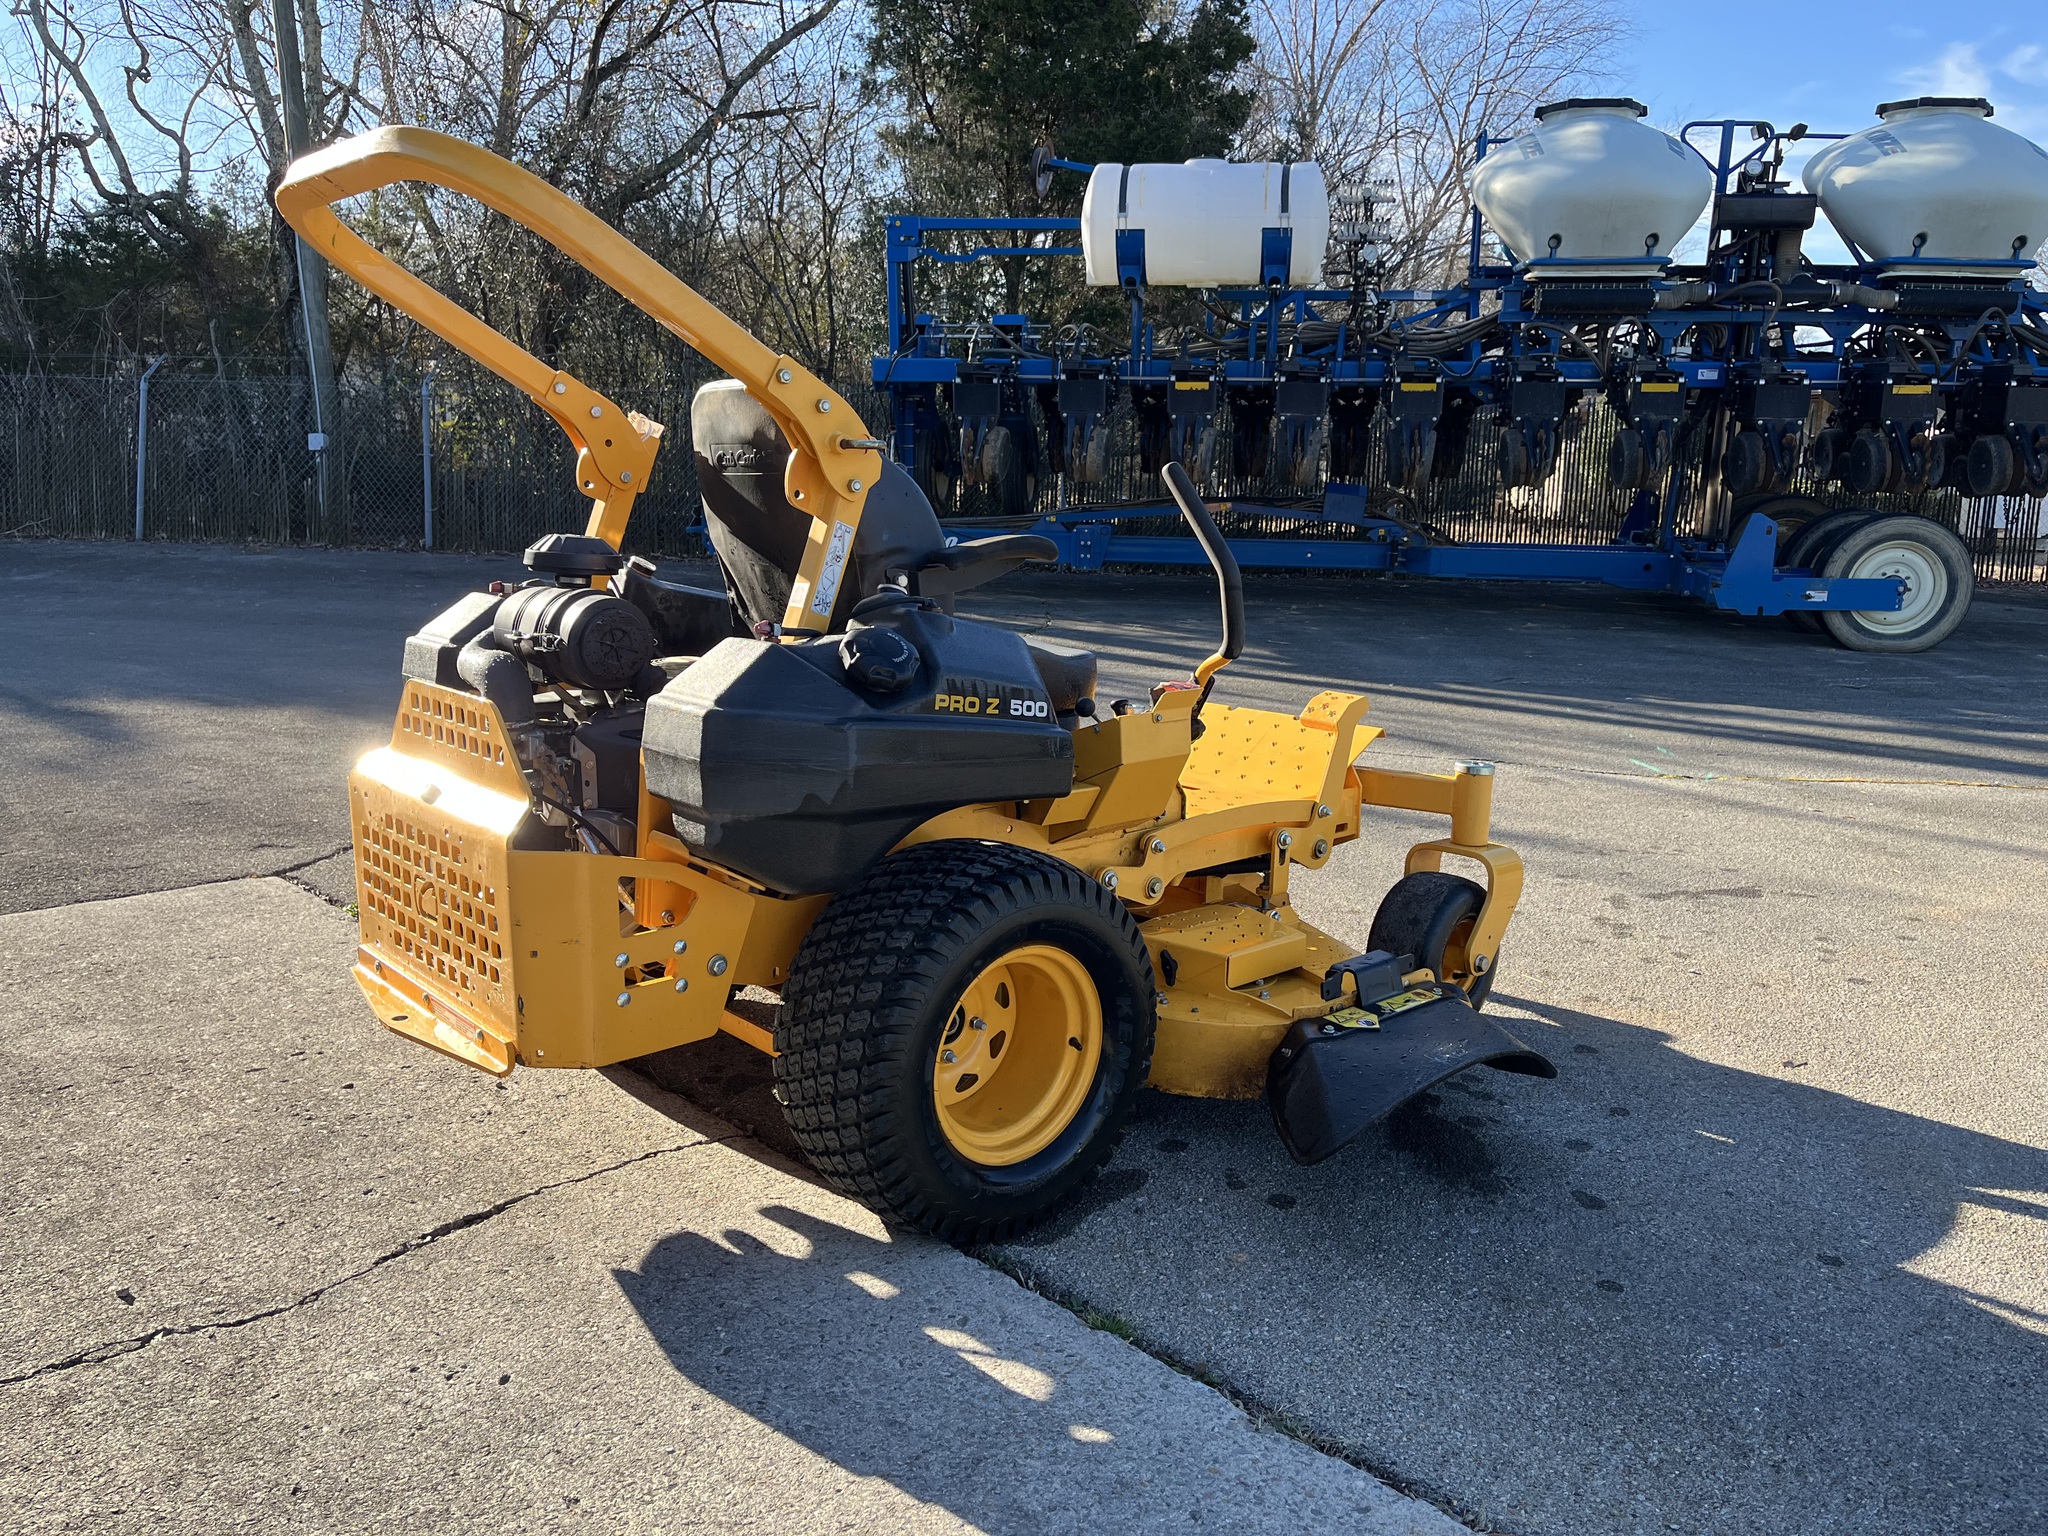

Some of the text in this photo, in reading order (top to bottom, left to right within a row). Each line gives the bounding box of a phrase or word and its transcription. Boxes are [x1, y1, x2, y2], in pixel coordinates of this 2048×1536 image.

[934, 693, 1048, 718] PRO Z 500
